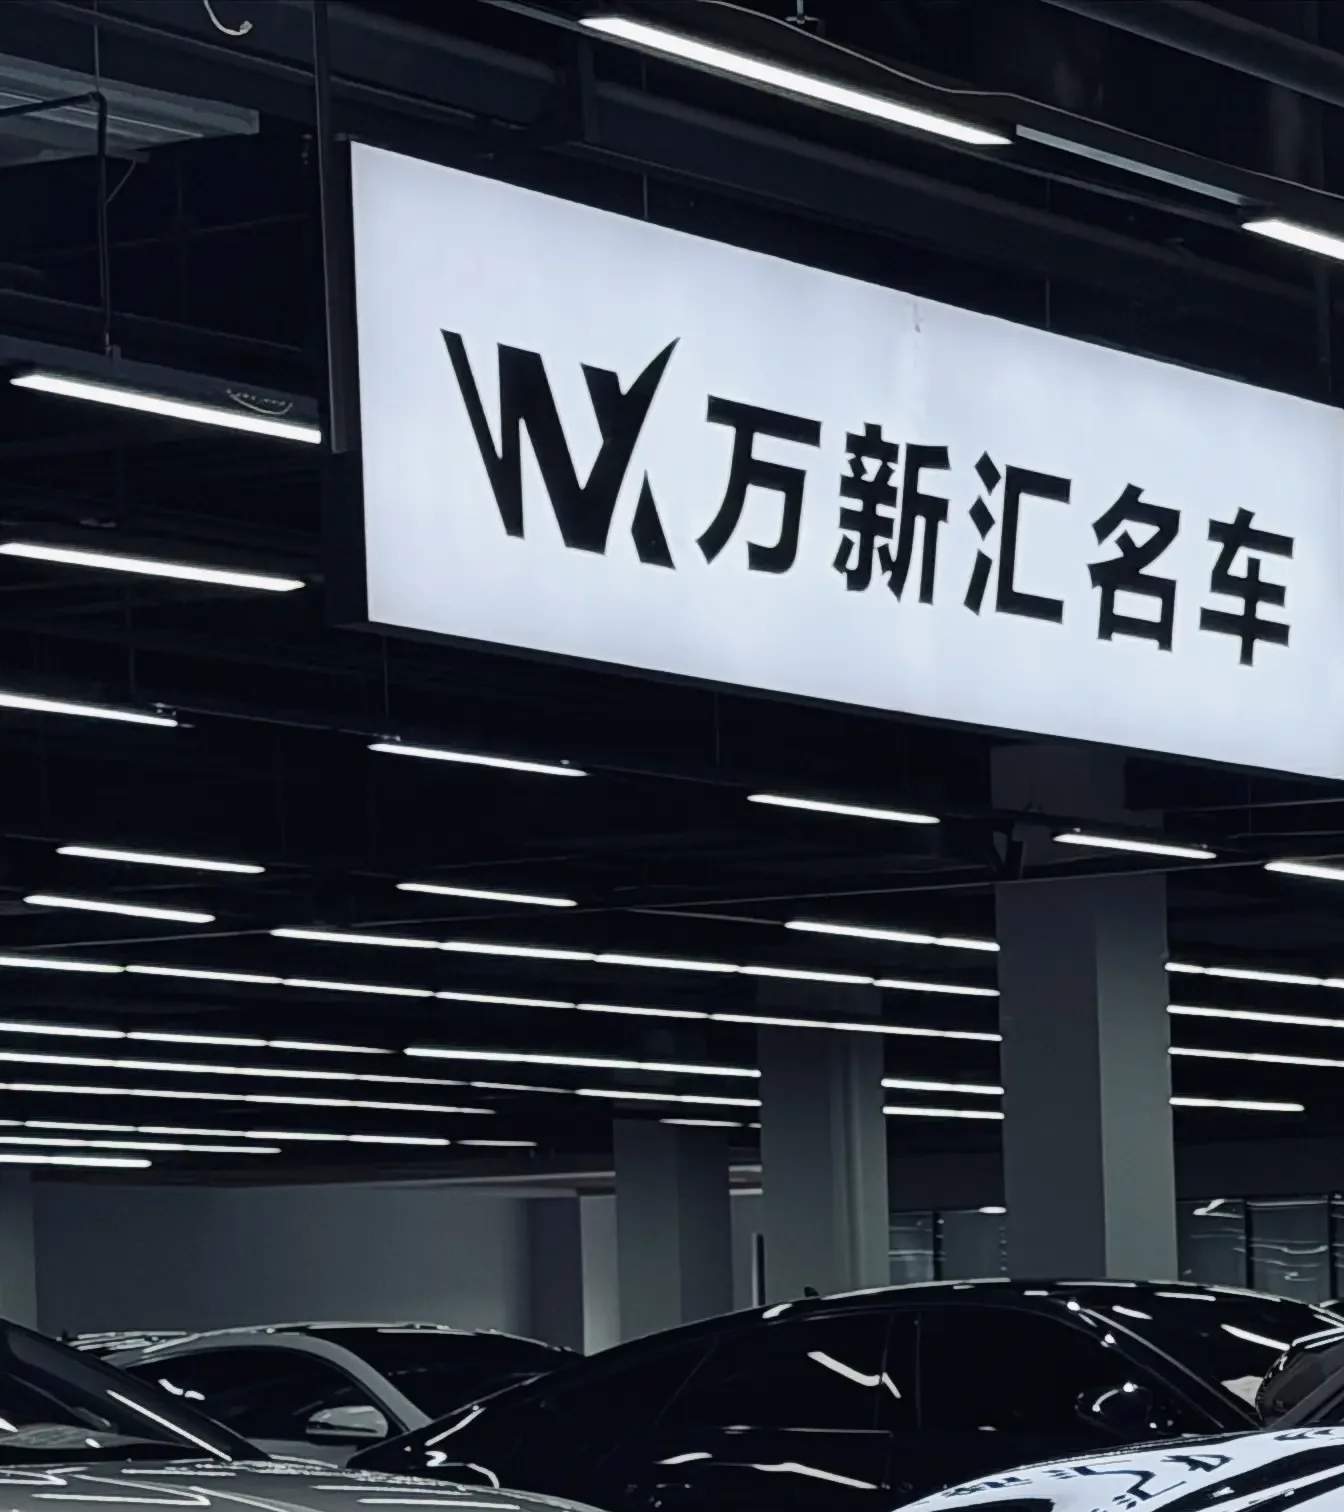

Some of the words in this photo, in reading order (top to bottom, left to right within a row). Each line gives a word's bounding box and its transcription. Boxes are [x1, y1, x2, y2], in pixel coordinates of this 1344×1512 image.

[694, 394, 1296, 667] 万新汇名车
